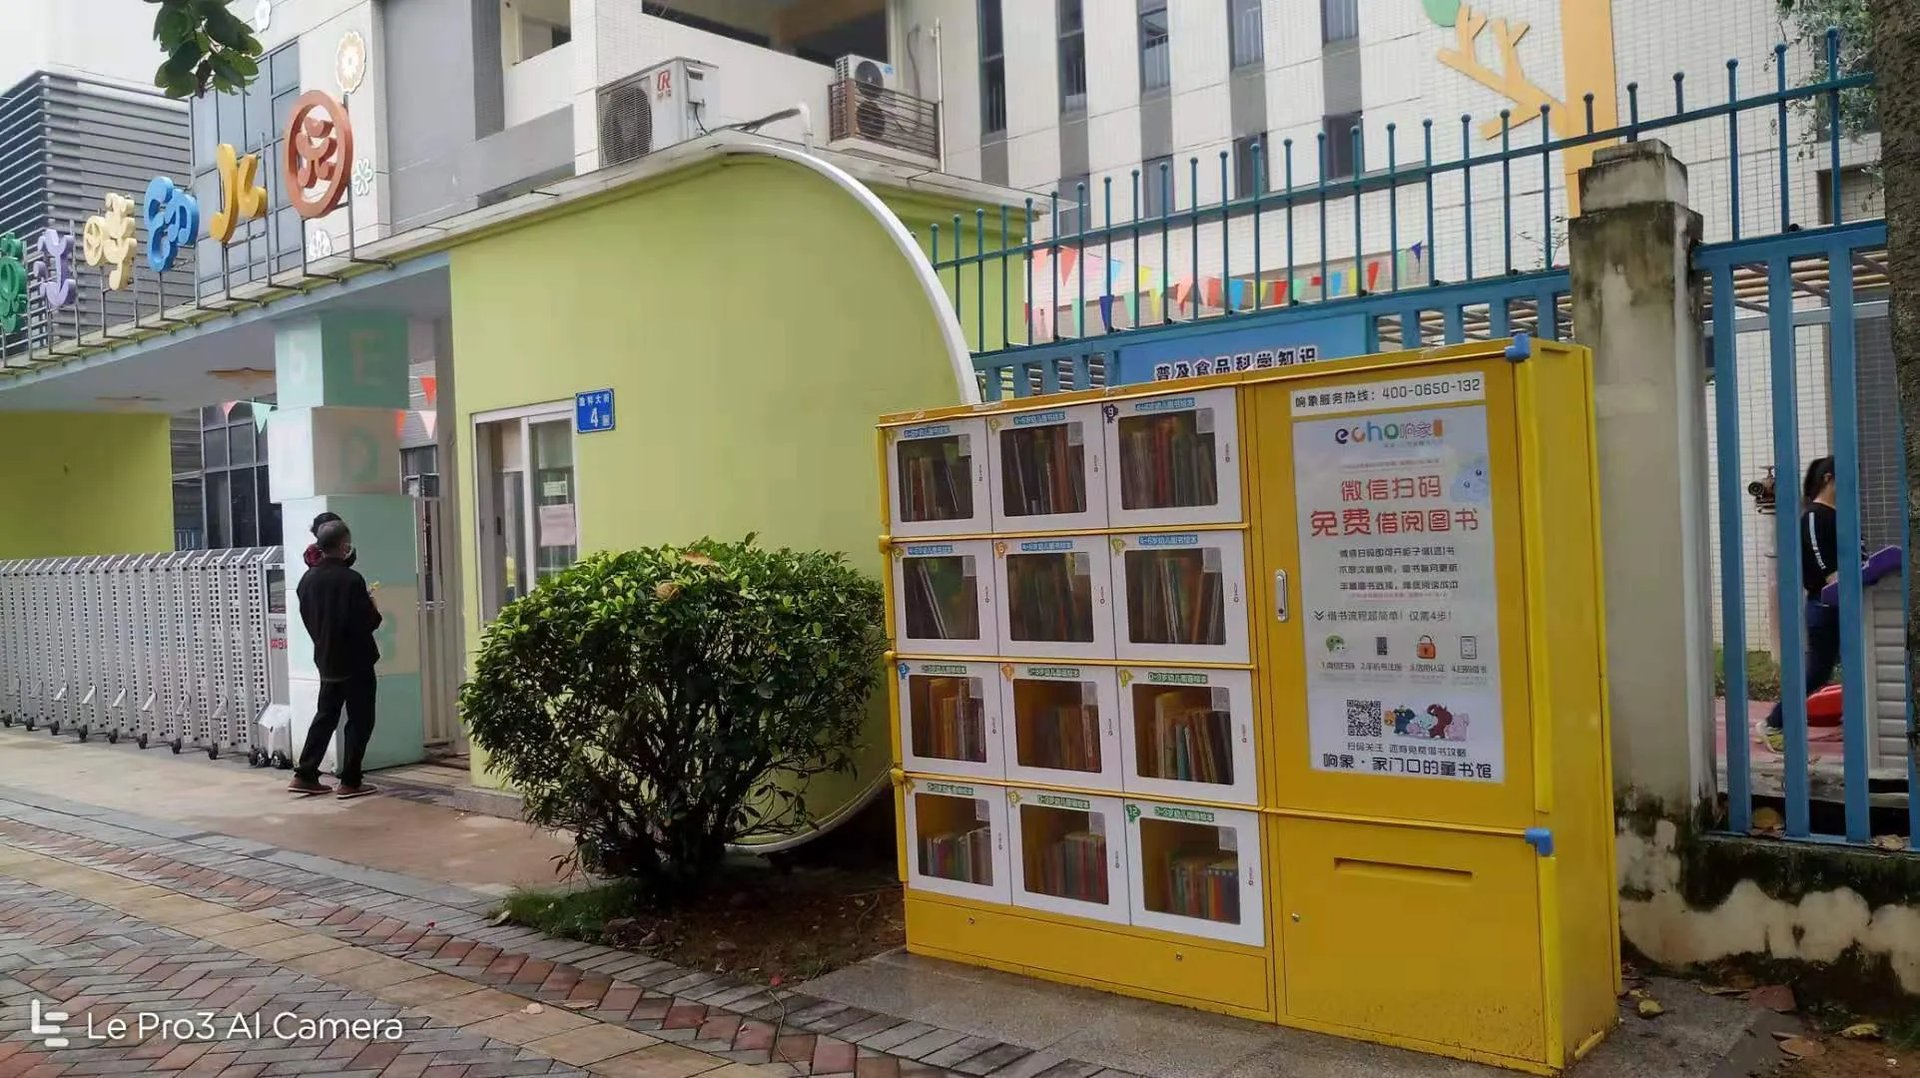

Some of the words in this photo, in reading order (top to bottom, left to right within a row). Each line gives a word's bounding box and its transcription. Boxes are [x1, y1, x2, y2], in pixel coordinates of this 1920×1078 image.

[1335, 421, 1398, 444] echo
[1341, 475, 1441, 502] 微信扫码
[1311, 507, 1478, 537] 免费借阅图书
